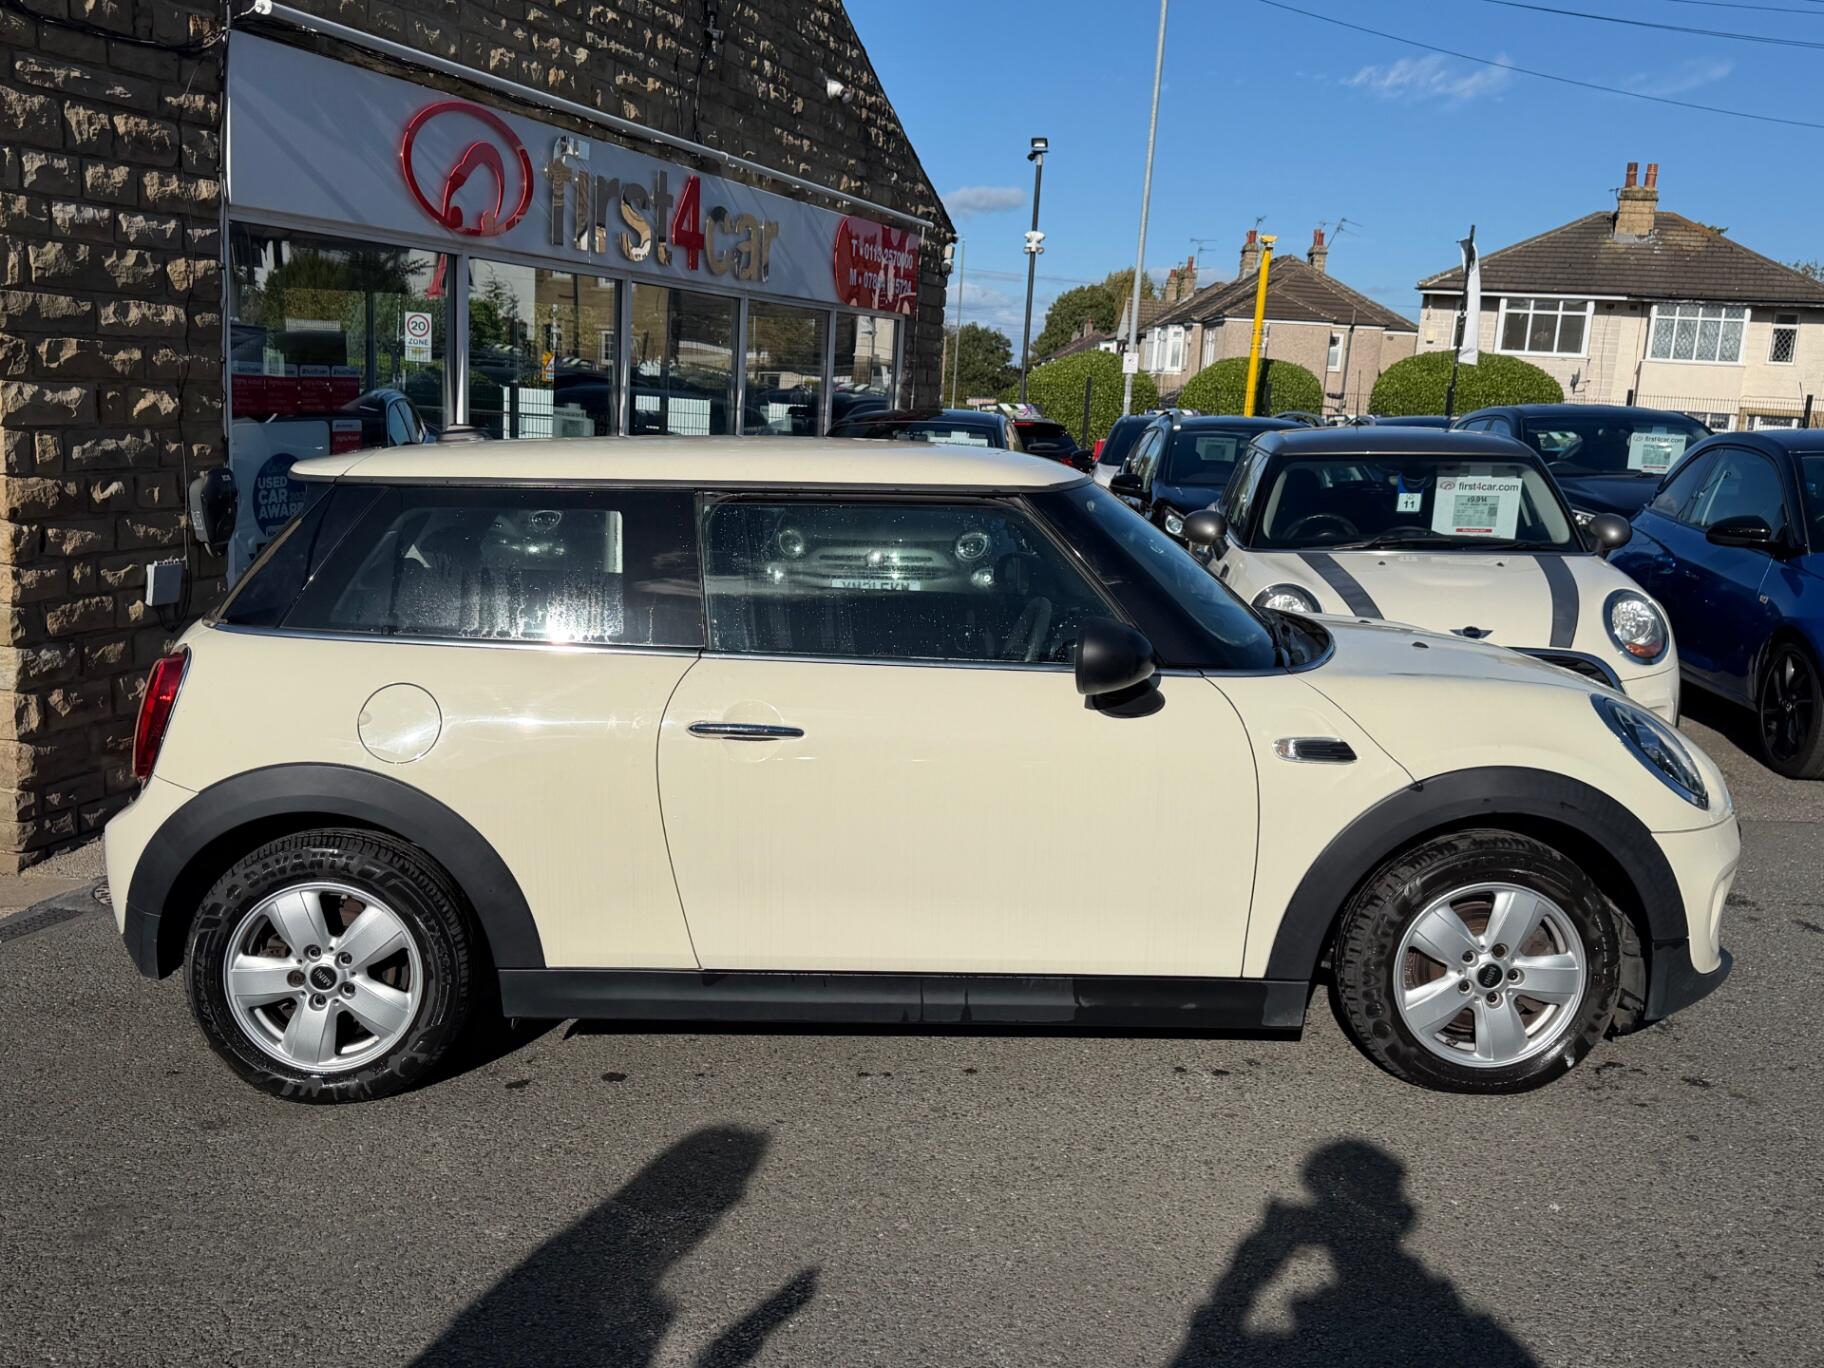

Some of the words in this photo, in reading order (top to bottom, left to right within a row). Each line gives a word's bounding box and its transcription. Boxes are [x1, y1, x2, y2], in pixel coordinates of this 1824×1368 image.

[545, 135, 779, 283] first4car
[851, 239, 858, 257] T
[864, 243, 882, 263] 0113
[849, 268, 857, 286] M
[410, 320, 426, 331] 20
[408, 337, 429, 346] ZONE
[257, 475, 288, 489] USED
[1458, 481, 1519, 492] first4car.com
[257, 488, 288, 505] CAR
[1403, 500, 1415, 509] 11
[313, 968, 333, 987] MINI
